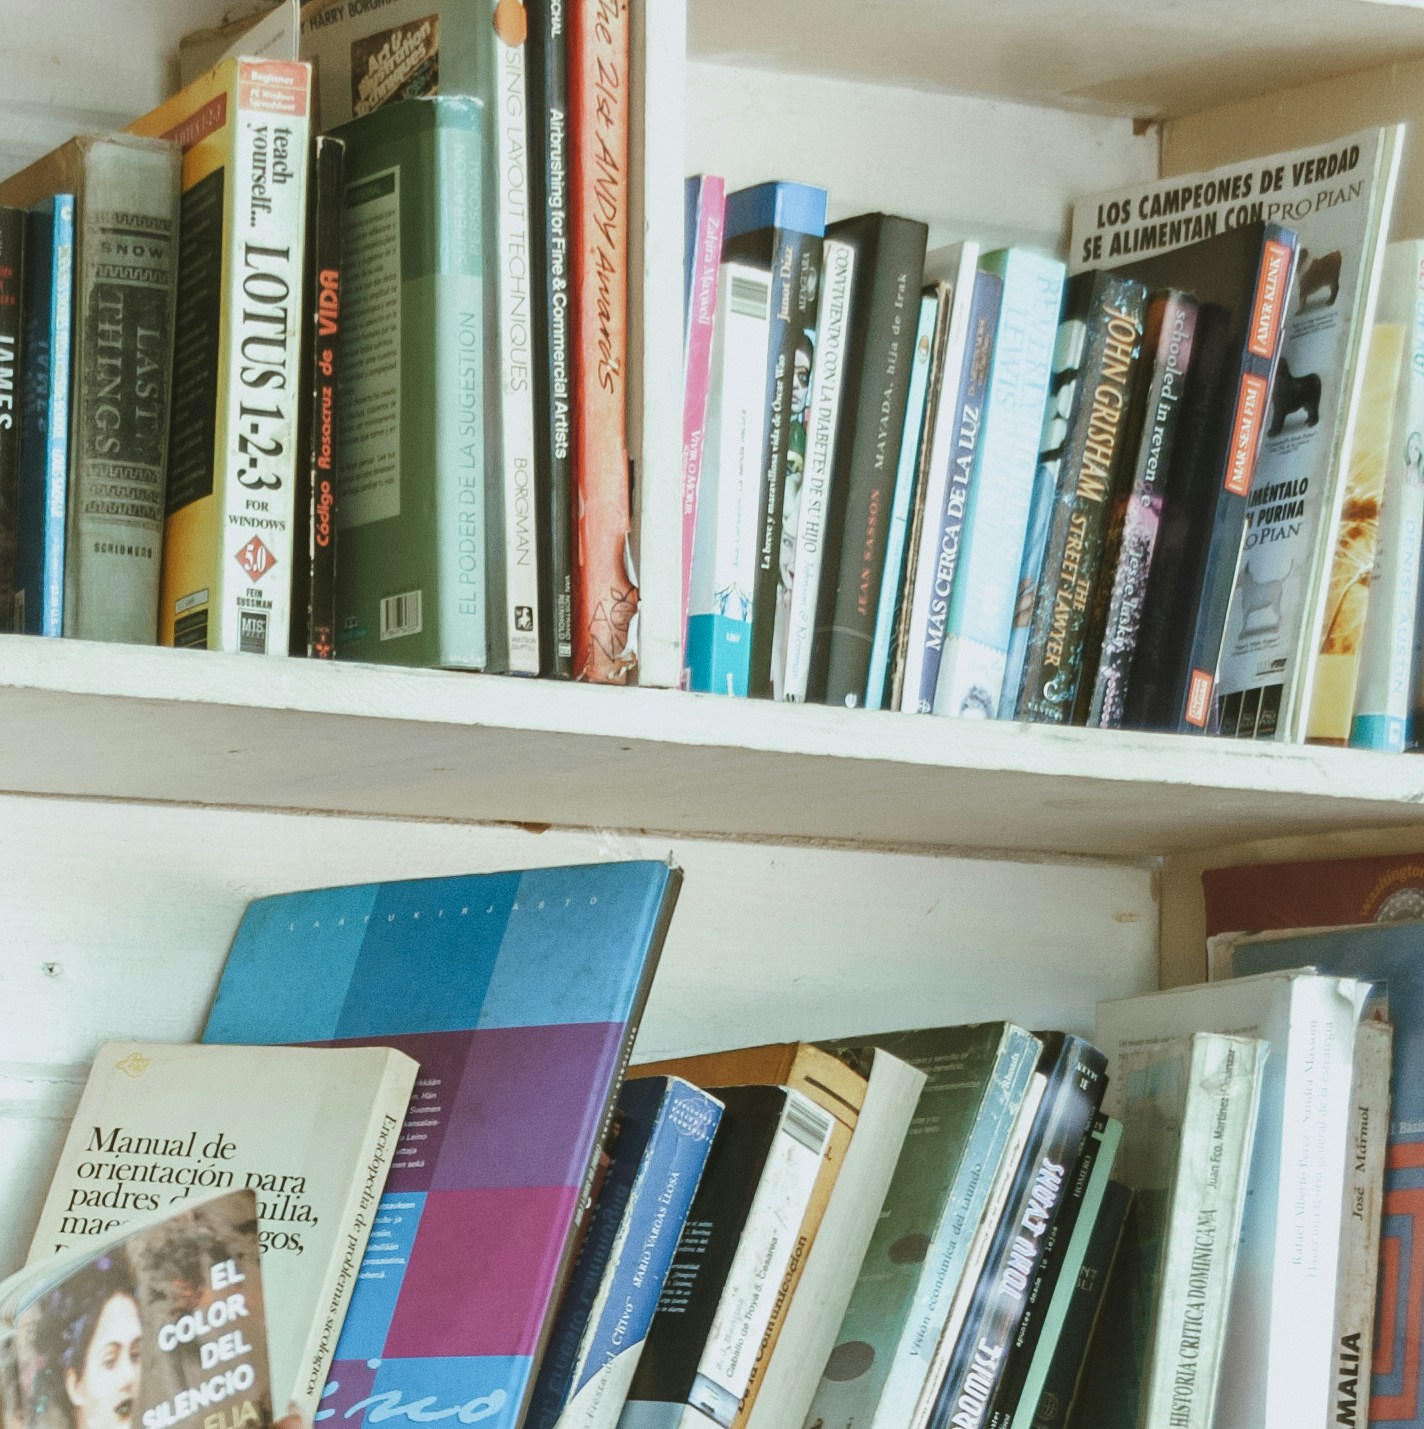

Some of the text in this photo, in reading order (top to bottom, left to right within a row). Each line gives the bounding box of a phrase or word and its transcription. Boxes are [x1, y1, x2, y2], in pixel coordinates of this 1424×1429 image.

[250, 71, 295, 86] Beginner
[272, 126, 295, 186] teach
[1096, 144, 1361, 230] LOS CAMPEONES DE VERDAD
[100, 241, 164, 260] SNOW
[505, 47, 529, 392] SING LAYOUT TECHNIQUES
[1081, 180, 1365, 263] SE ALIMENTAN CON PRO PLAN
[548, 107, 570, 460] Airbrushing for Fine & Commercial Artists
[698, 216, 721, 326] Zahira Maxwell
[1256, 256, 1281, 346] AMYR KLINK
[94, 291, 124, 455] THINGS
[236, 241, 292, 491] LOTUS 1-2-3
[316, 267, 341, 547] Código Rosacruz de VIDA
[1075, 302, 1138, 502] JOHN GRISHAM
[1232, 387, 1258, 483] MAR SEM FIM
[228, 514, 286, 532] WINDOWS
[245, 498, 270, 513] FOR
[513, 456, 530, 566] BORGMAN
[1256, 499, 1305, 528] PURINA
[244, 543, 268, 573] 5.0
[857, 488, 880, 616] JEAN SASSON
[235, 596, 274, 610] SUSSMAN
[246, 587, 264, 599] FEIN
[76, 1155, 307, 1197] orientación para
[85, 1126, 237, 1160] Manual de
[363, 1112, 398, 1208] Enciclopedia
[1351, 1105, 1370, 1222] José Mármol
[66, 1182, 160, 1213] padres
[356, 1208, 367, 1233] de
[209, 1257, 246, 1291] EL
[328, 1234, 359, 1316] problemas
[1187, 1207, 1218, 1300] DOMINICANA
[157, 1293, 250, 1352] COLOR
[200, 1329, 253, 1370] DEL
[1180, 1303, 1206, 1360] CRITICA
